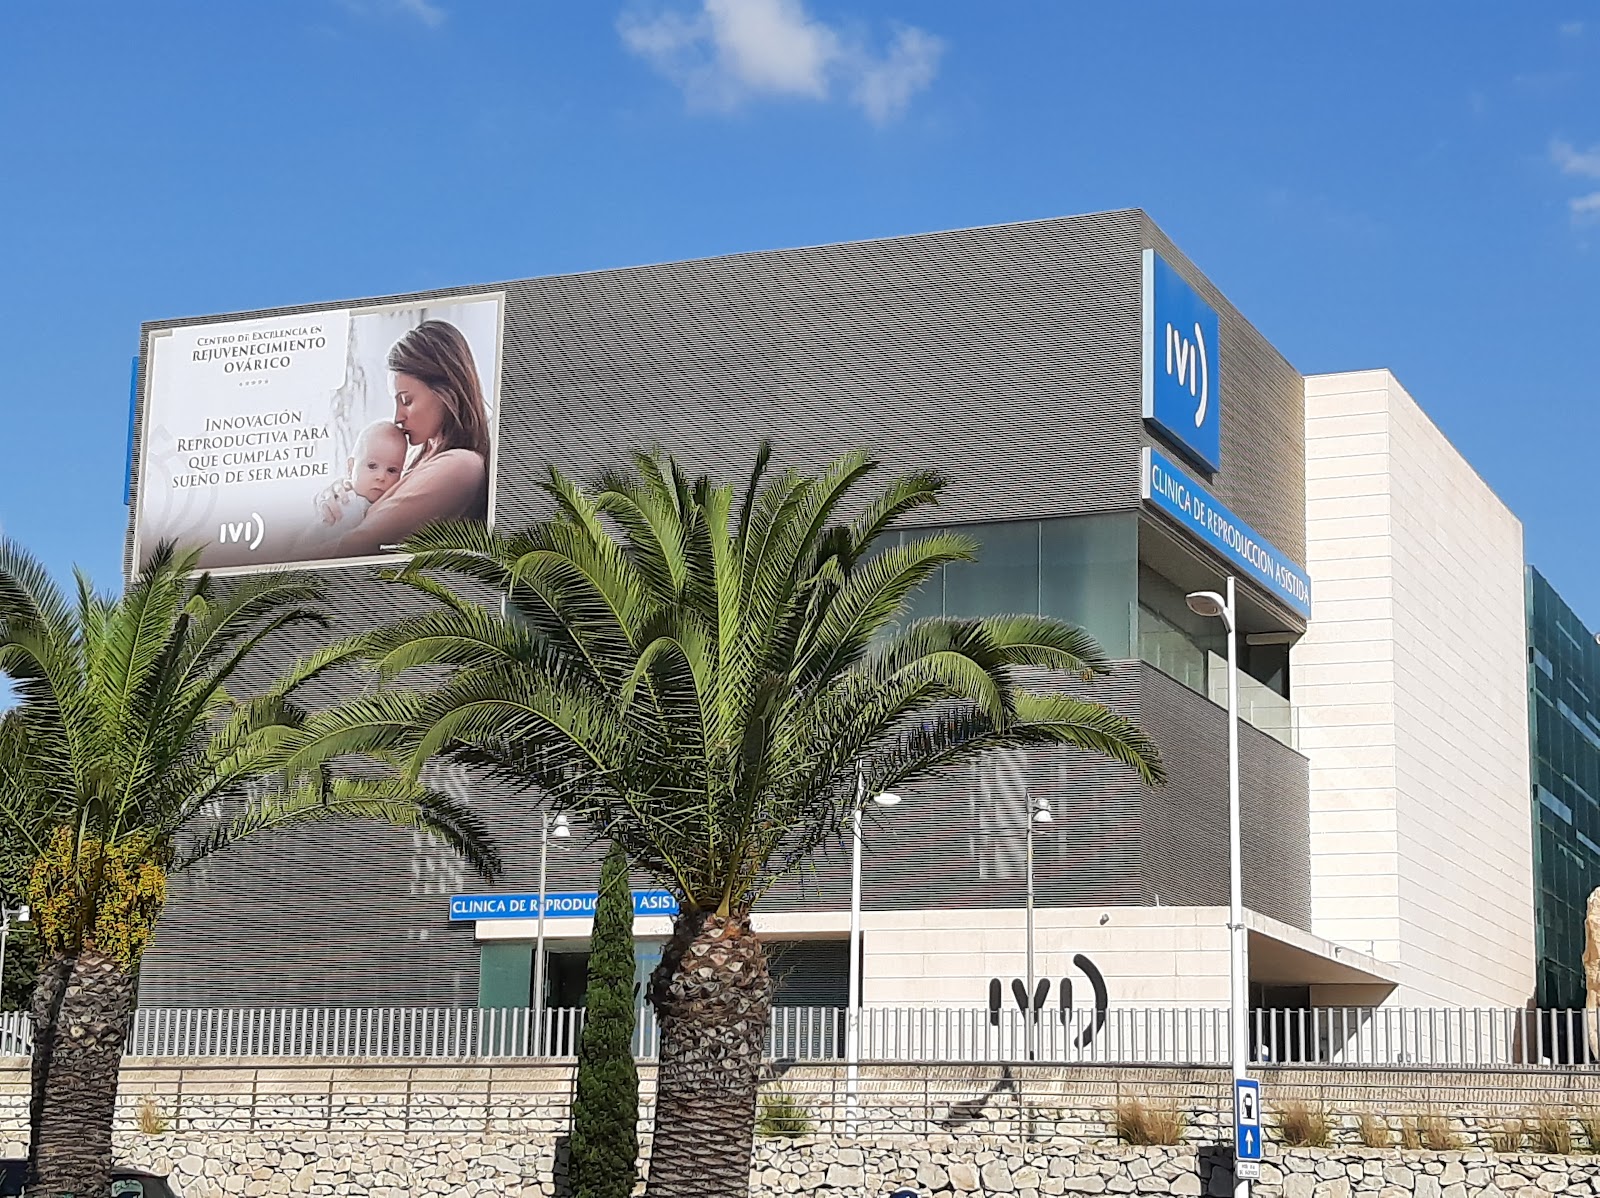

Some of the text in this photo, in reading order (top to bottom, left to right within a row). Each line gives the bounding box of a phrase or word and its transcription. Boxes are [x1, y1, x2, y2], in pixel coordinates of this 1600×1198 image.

[197, 335, 235, 347] CENTRO
[310, 325, 323, 334] EN
[192, 336, 326, 363] REJUVENECIMIENTO
[224, 356, 291, 374] OVÁRICO
[205, 409, 303, 432] INNOVACIÓN
[177, 425, 329, 452] REPRODUCTIVA PARA
[188, 446, 315, 471] QUE CUMPLAS TU
[172, 462, 329, 489] SUEÑO DE SER MADRE
[1152, 464, 1310, 607] CLINICA DE REPRODUCCION ASISTIDA
[452, 900, 506, 914] CLINICA
[509, 899, 527, 912] DE
[640, 895, 676, 909] ASIST
